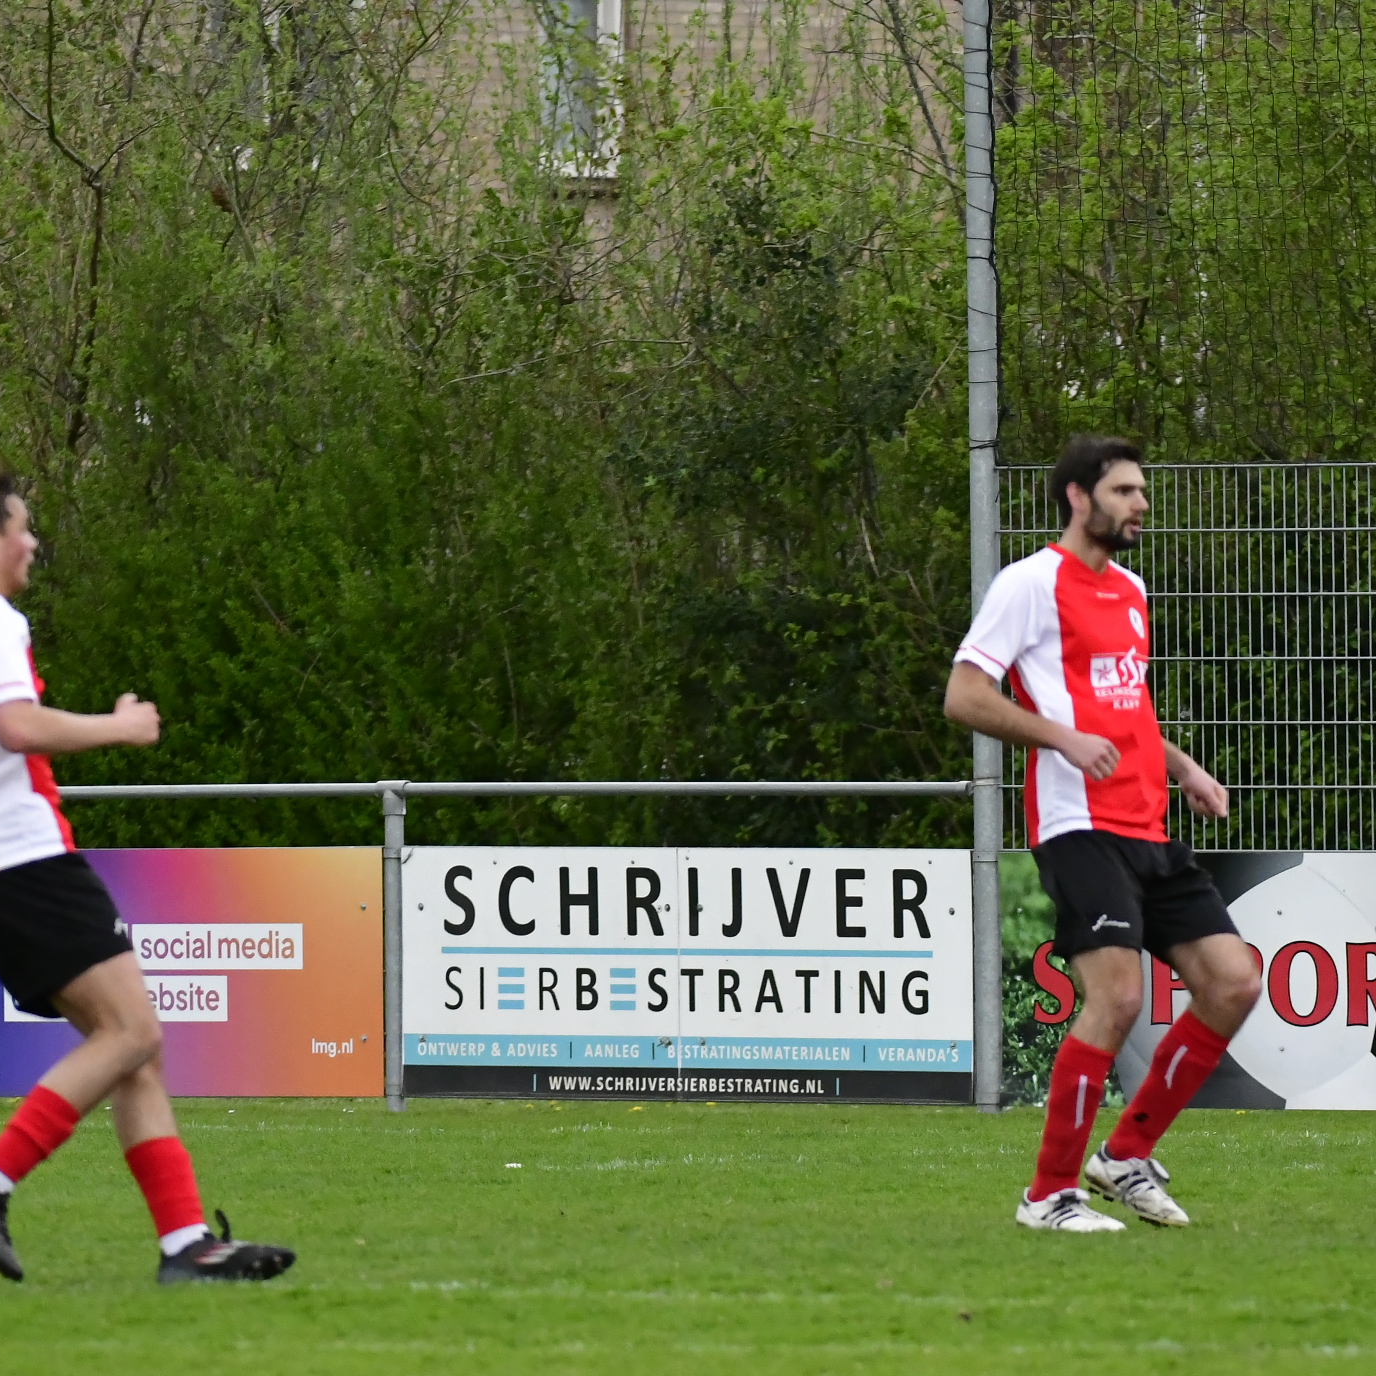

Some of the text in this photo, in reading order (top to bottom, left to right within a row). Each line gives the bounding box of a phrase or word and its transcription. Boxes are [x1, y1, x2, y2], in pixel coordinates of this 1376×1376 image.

[442, 864, 932, 939] SCHRIJVER
[140, 930, 295, 960] social media
[146, 983, 220, 1011] ebsite
[444, 965, 930, 1015] SIERBESTRATING
[311, 1038, 354, 1058] lmg.nl
[417, 1042, 960, 1063] ONTWERP & ADVIES AANLEG BESTRATINGSMATERIALEN VERANDA'S
[548, 1075, 825, 1094] WWW.SCHRIJVERSIERBESTRATING.NL
